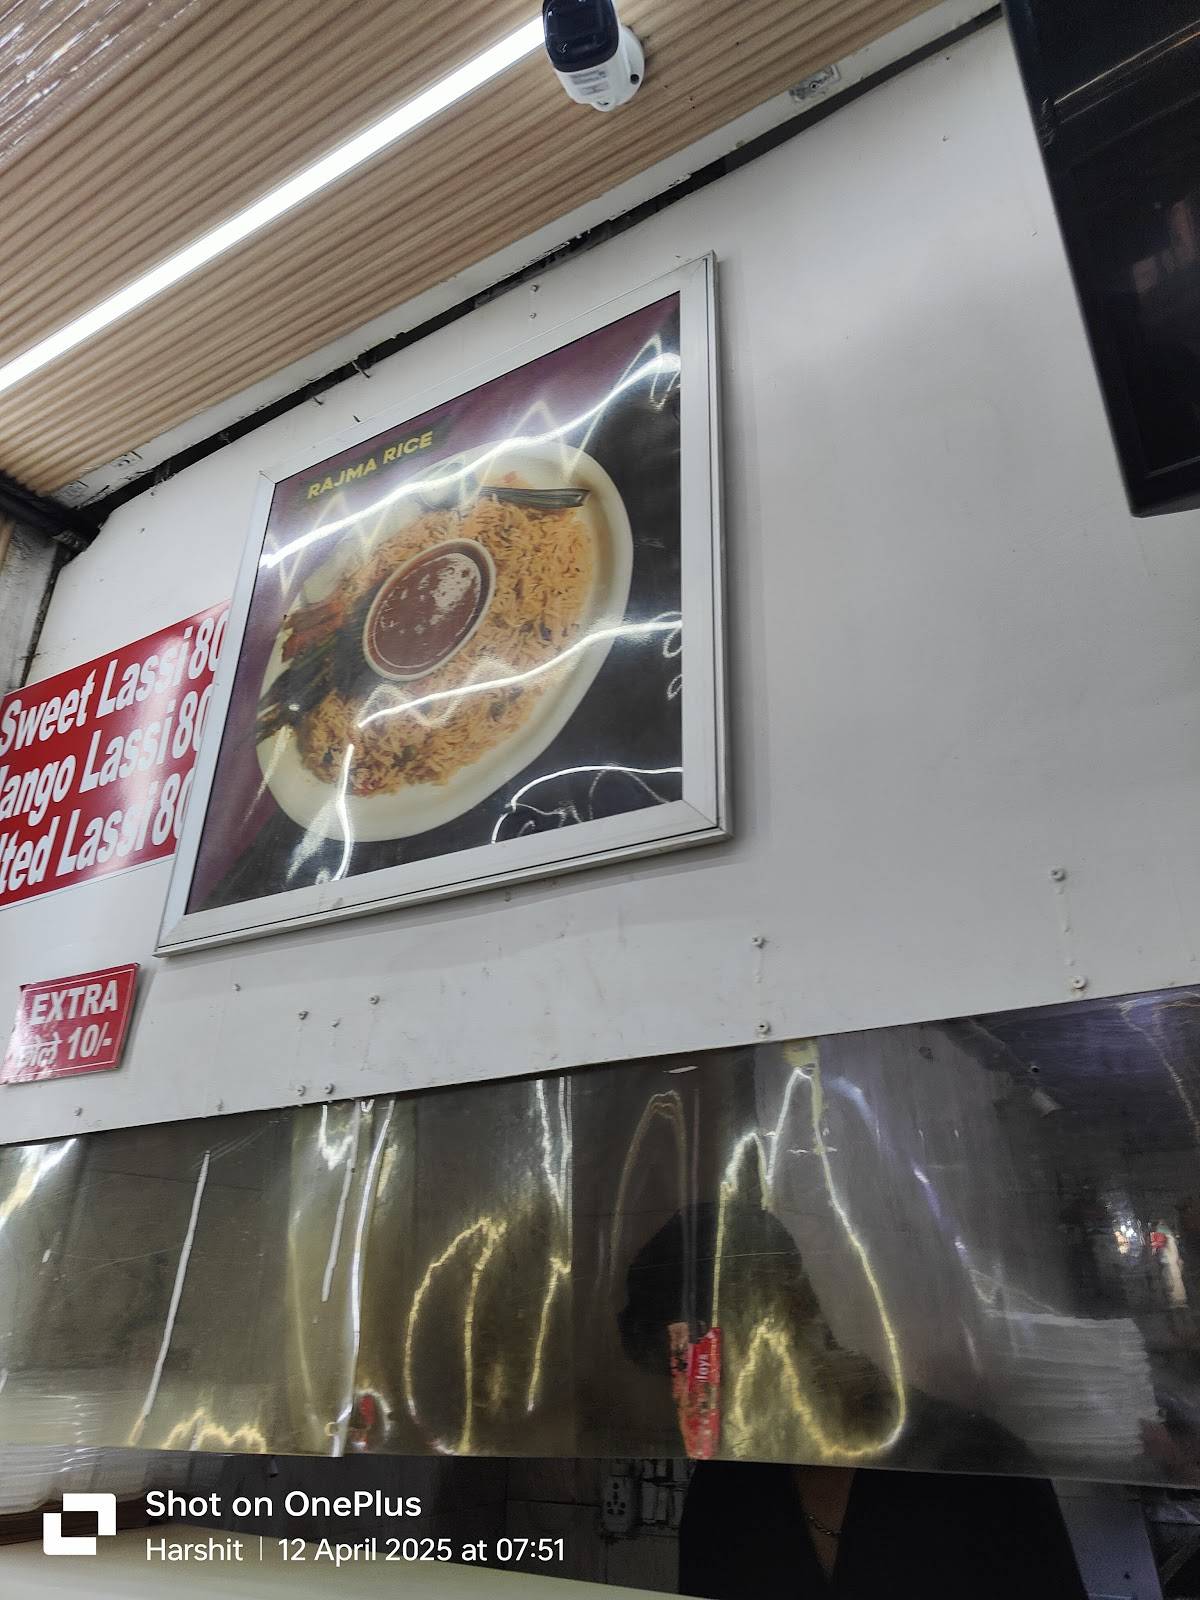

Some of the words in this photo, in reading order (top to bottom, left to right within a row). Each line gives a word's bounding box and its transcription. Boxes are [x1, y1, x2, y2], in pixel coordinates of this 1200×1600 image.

[307, 458, 377, 499] RAJMA
[383, 431, 433, 464] RICE
[0, 668, 95, 757] Sweet
[96, 626, 193, 719] Lassi
[187, 608, 229, 680] 80
[79, 699, 176, 793] Lassi
[56, 780, 159, 877] Lassi
[29, 979, 118, 1025] EXTRA
[67, 1022, 112, 1060] 10/-
